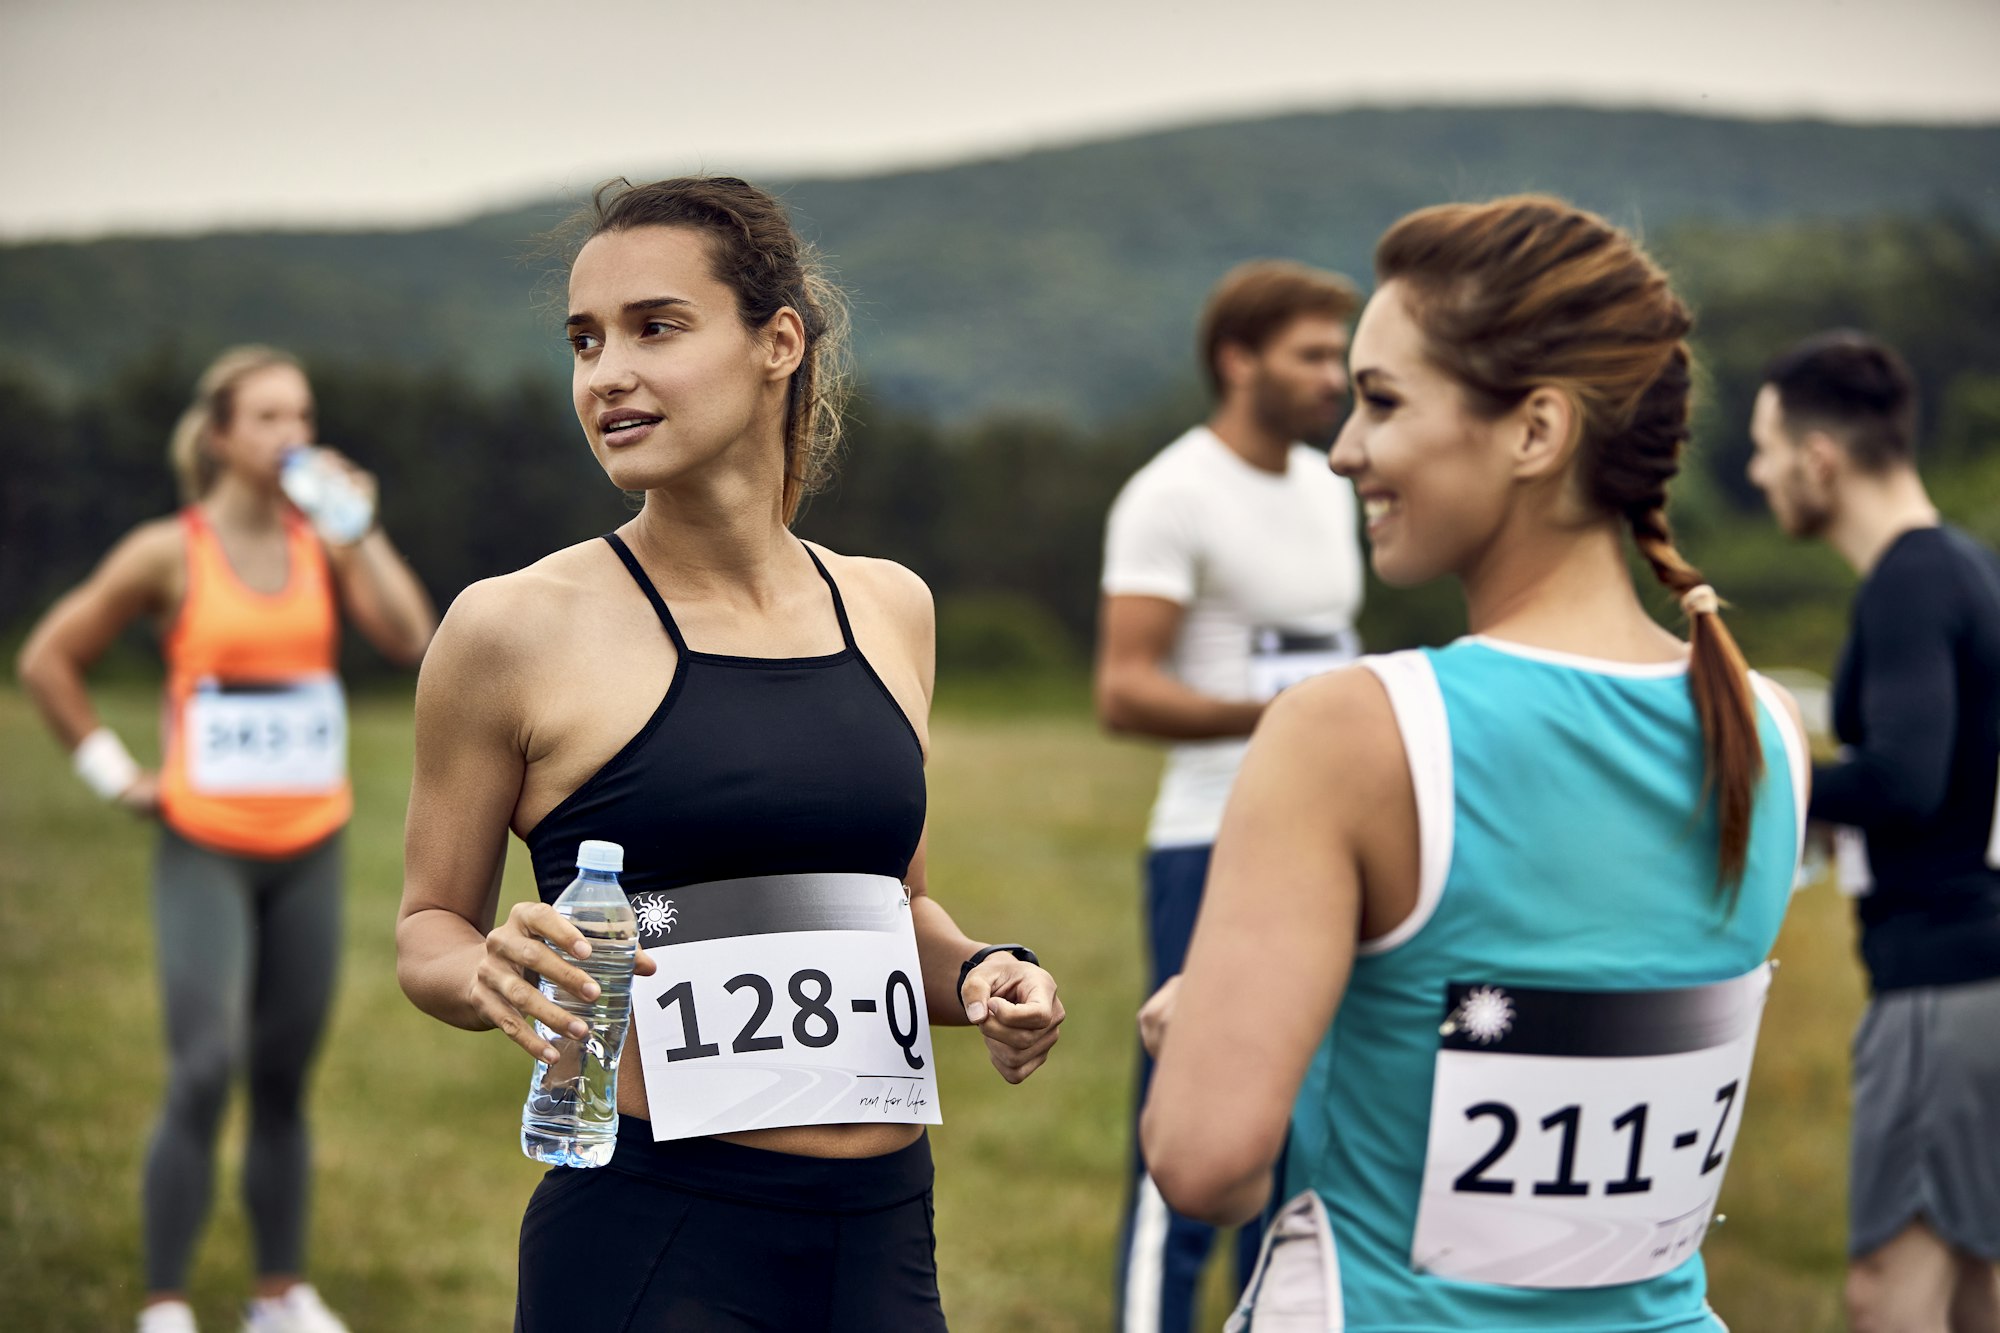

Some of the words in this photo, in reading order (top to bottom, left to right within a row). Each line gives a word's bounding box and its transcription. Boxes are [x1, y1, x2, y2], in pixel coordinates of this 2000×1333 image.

[656, 968, 925, 1070] 128-Q
[859, 1096, 879, 1108] run
[884, 1086, 902, 1114] for
[907, 1082, 927, 1115] life
[1452, 1079, 1739, 1197] 211-Z
